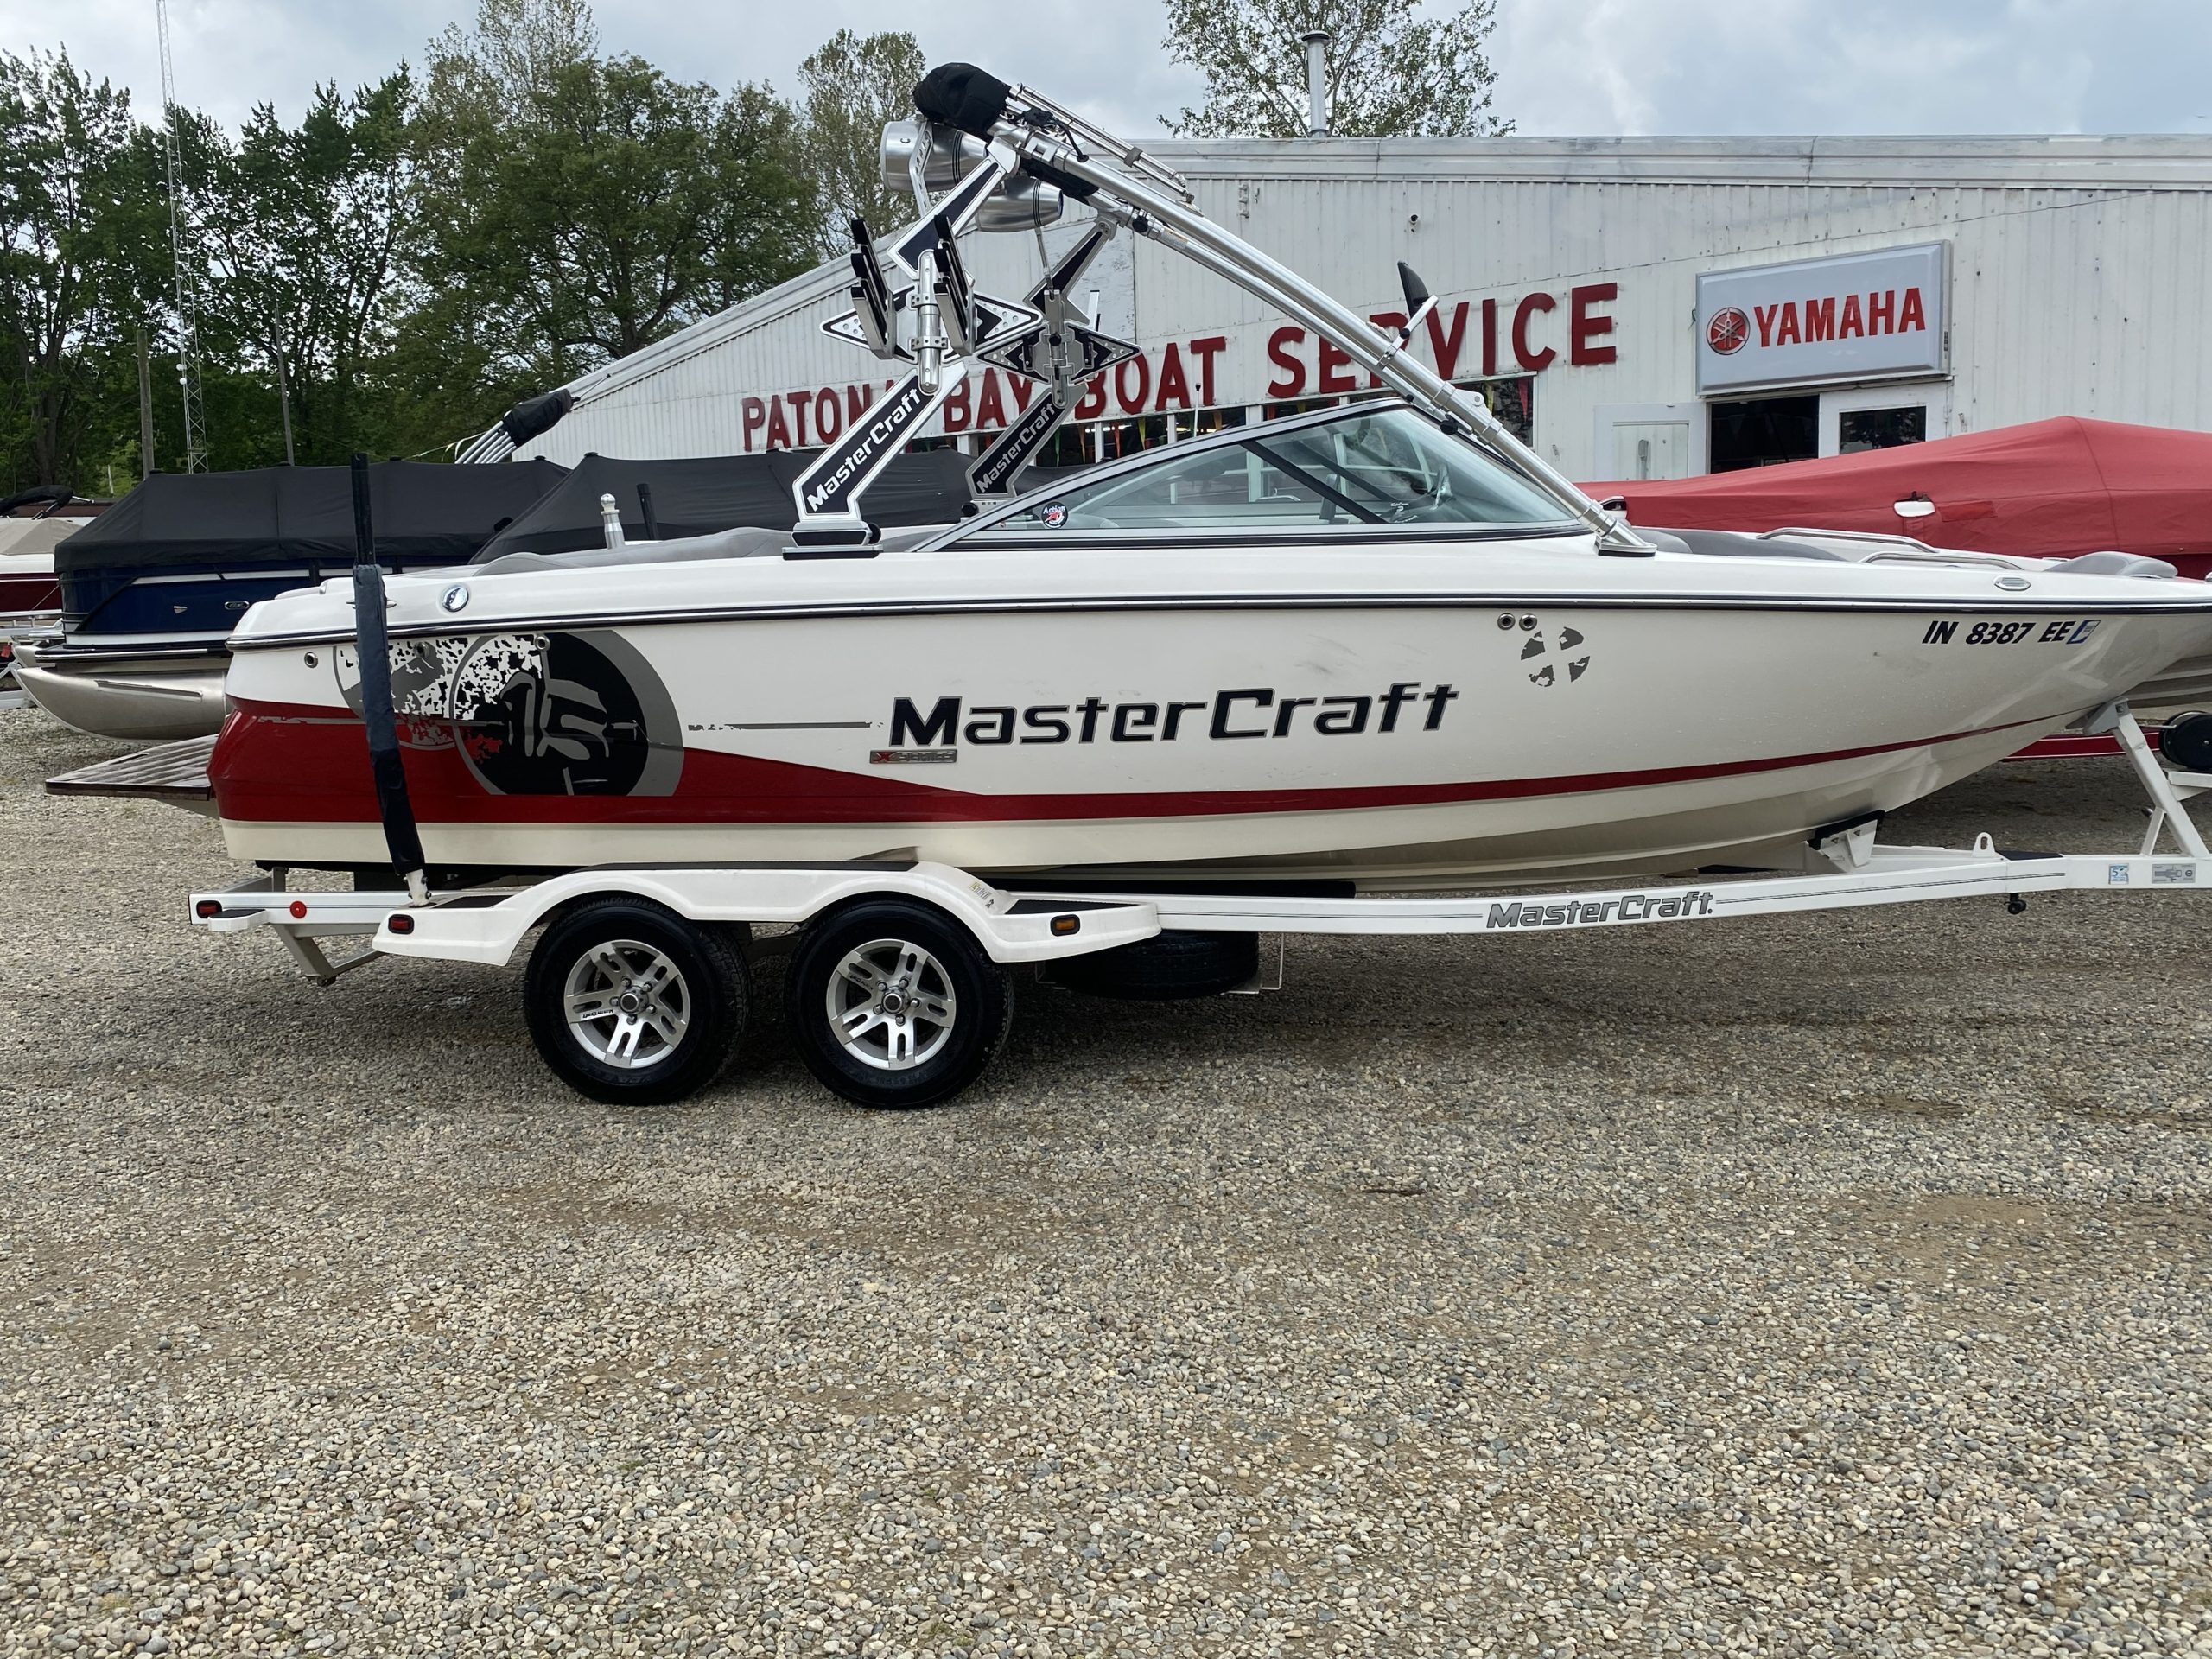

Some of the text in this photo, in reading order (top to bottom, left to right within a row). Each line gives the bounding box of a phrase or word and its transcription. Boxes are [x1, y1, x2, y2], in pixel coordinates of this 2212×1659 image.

[1753, 287, 1926, 348] YAMAHA
[742, 282, 1618, 452] PATON BAY BOAT SERVICE
[805, 387, 922, 512] MasterCraft
[976, 399, 1056, 493] MasterCraft
[1922, 620, 2076, 645] IN 8387 EE
[888, 681, 1460, 747] MasterCraft
